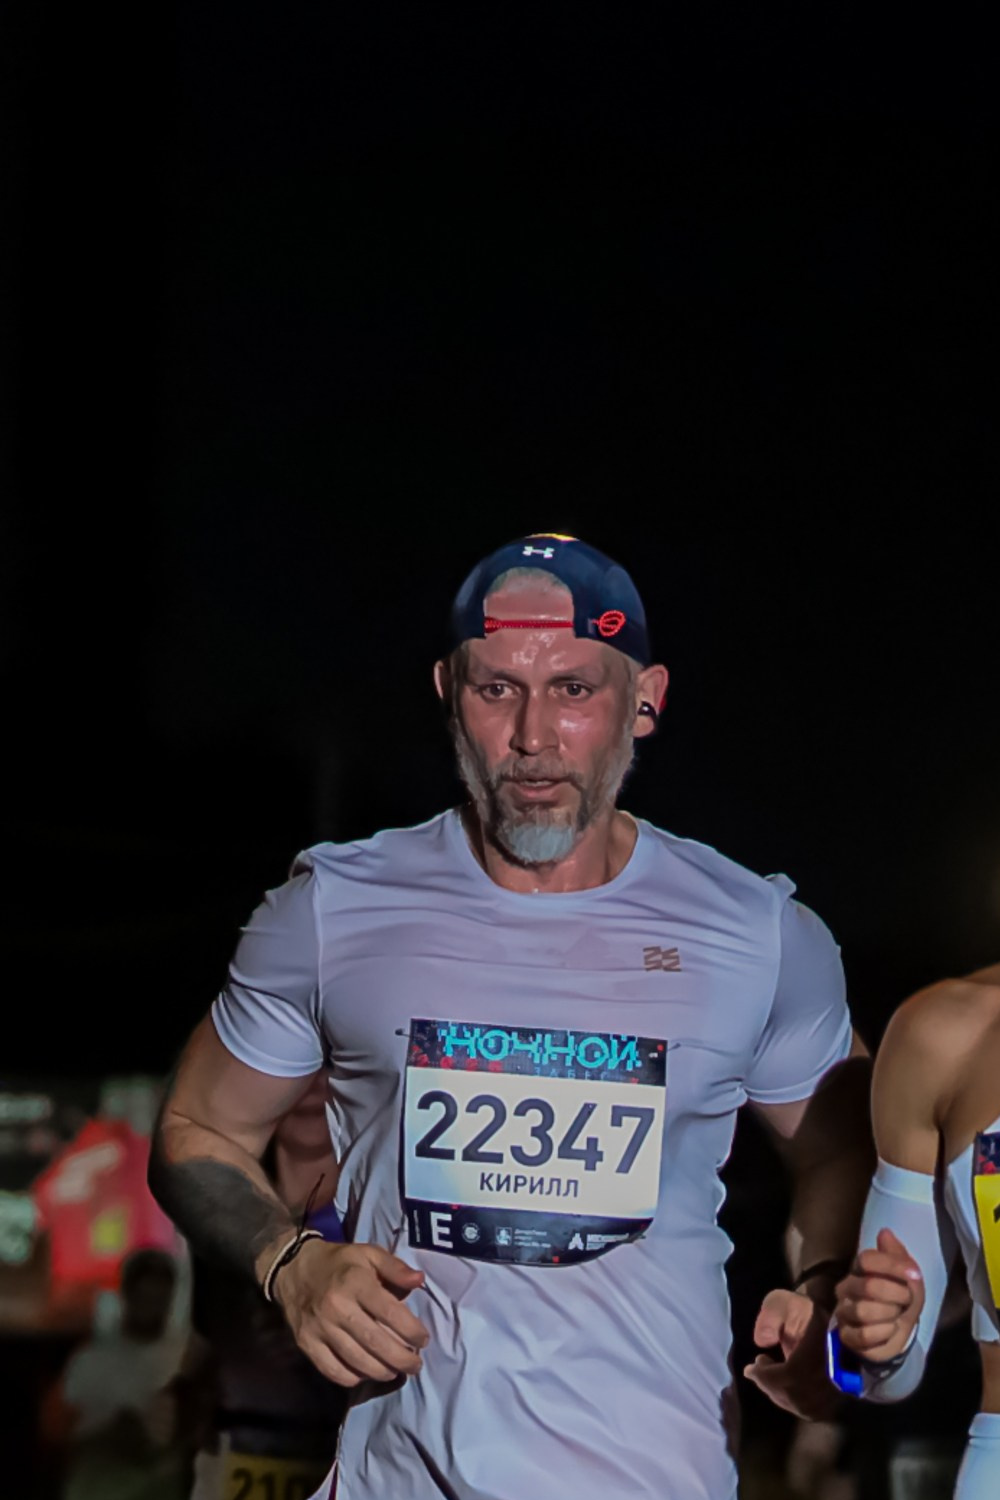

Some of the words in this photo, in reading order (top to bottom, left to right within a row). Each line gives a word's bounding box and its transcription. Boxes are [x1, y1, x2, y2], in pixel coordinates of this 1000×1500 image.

[438, 1022, 642, 1071] НОЧНОЙ
[415, 1090, 655, 1174] 22347
[479, 1172, 579, 1198] КИРИЛЛ
[429, 1210, 454, 1249] E
